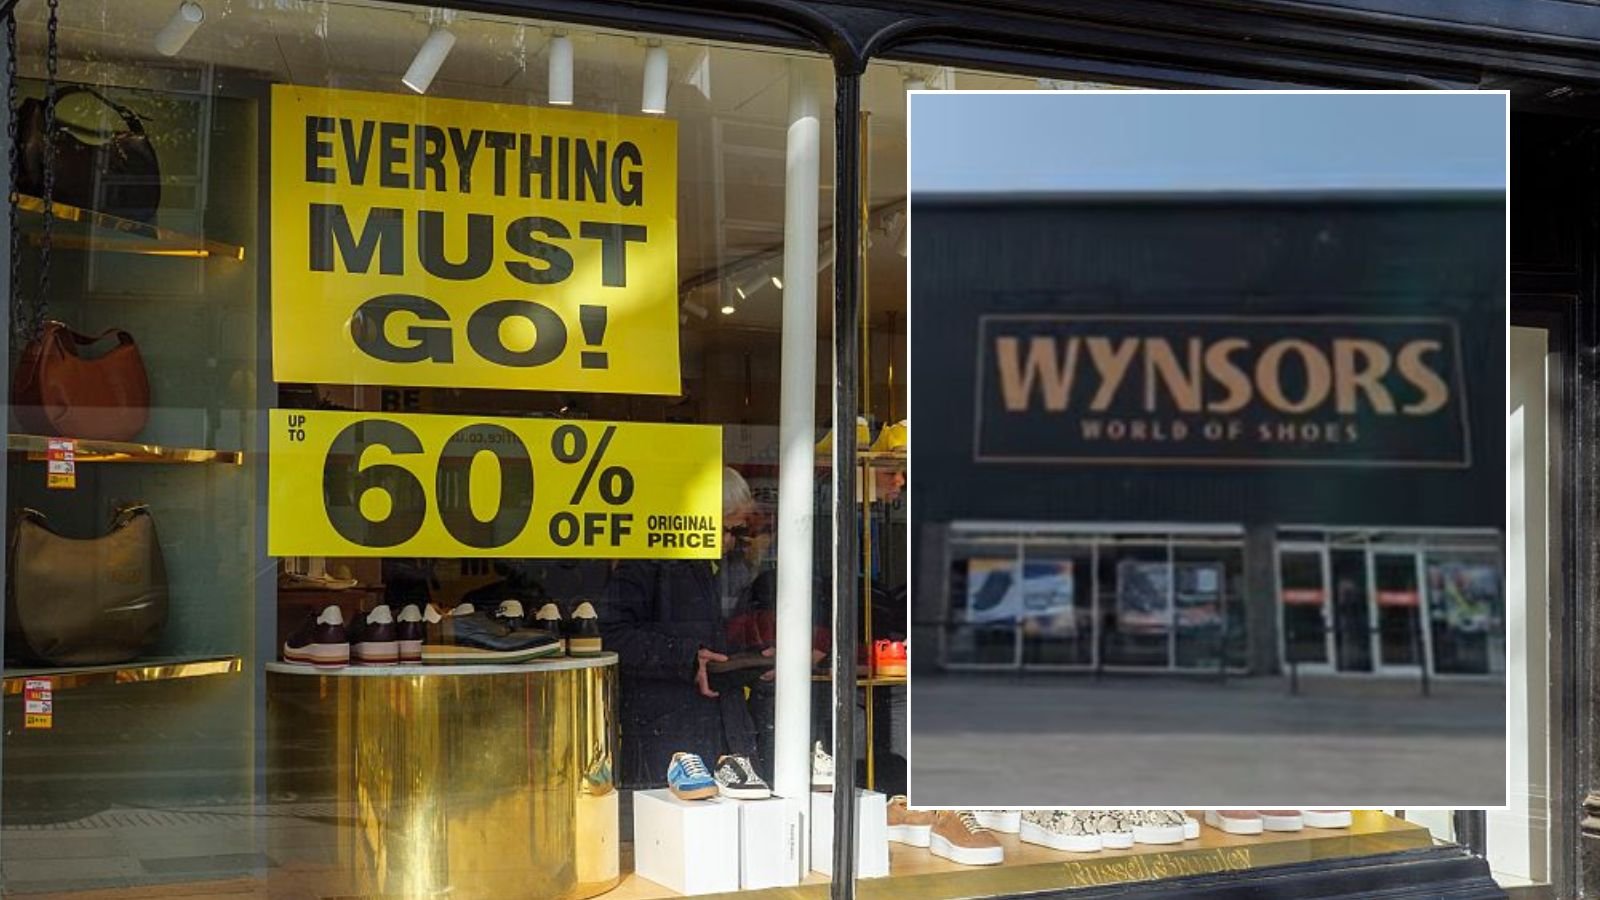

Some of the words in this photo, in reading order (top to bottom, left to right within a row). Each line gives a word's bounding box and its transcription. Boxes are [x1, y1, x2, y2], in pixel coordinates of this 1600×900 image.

[304, 115, 644, 207] EVERYTHING
[308, 202, 648, 289] MUST
[350, 293, 609, 371] GO!
[996, 336, 1450, 416] WYNSORS
[287, 414, 307, 428] UP
[287, 428, 307, 442] TO
[1082, 420, 1188, 441] WORLD
[1203, 421, 1239, 440] OF
[1259, 422, 1358, 442] SHOES
[548, 511, 634, 547] OFF
[647, 514, 717, 531] ORIGINAL
[647, 532, 716, 548] PRICE
